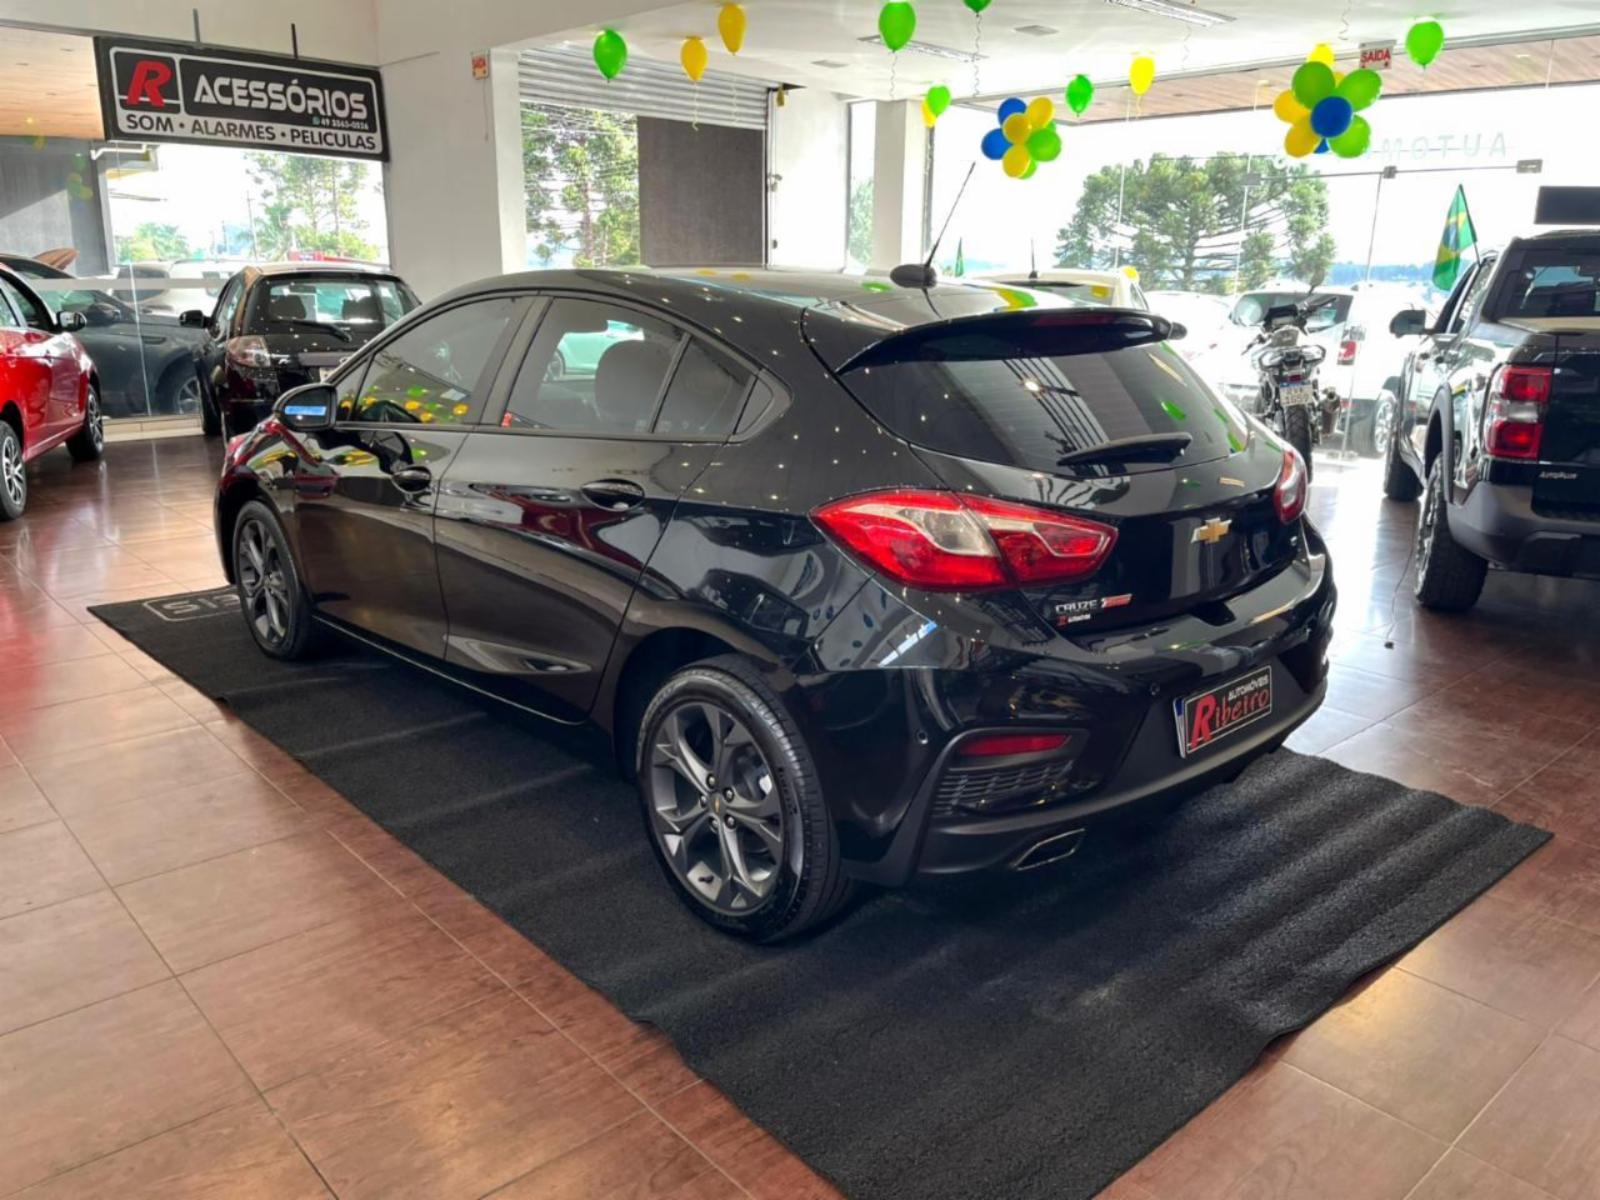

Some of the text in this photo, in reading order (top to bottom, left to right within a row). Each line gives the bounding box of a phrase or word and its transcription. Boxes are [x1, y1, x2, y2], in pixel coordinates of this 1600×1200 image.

[193, 74, 368, 120] ACESSÓRIOS
[126, 113, 376, 150] SOM ALARMES PELICULAS
[1055, 599, 1098, 614] CRUZE
[1190, 688, 1270, 749] Ribeiro
